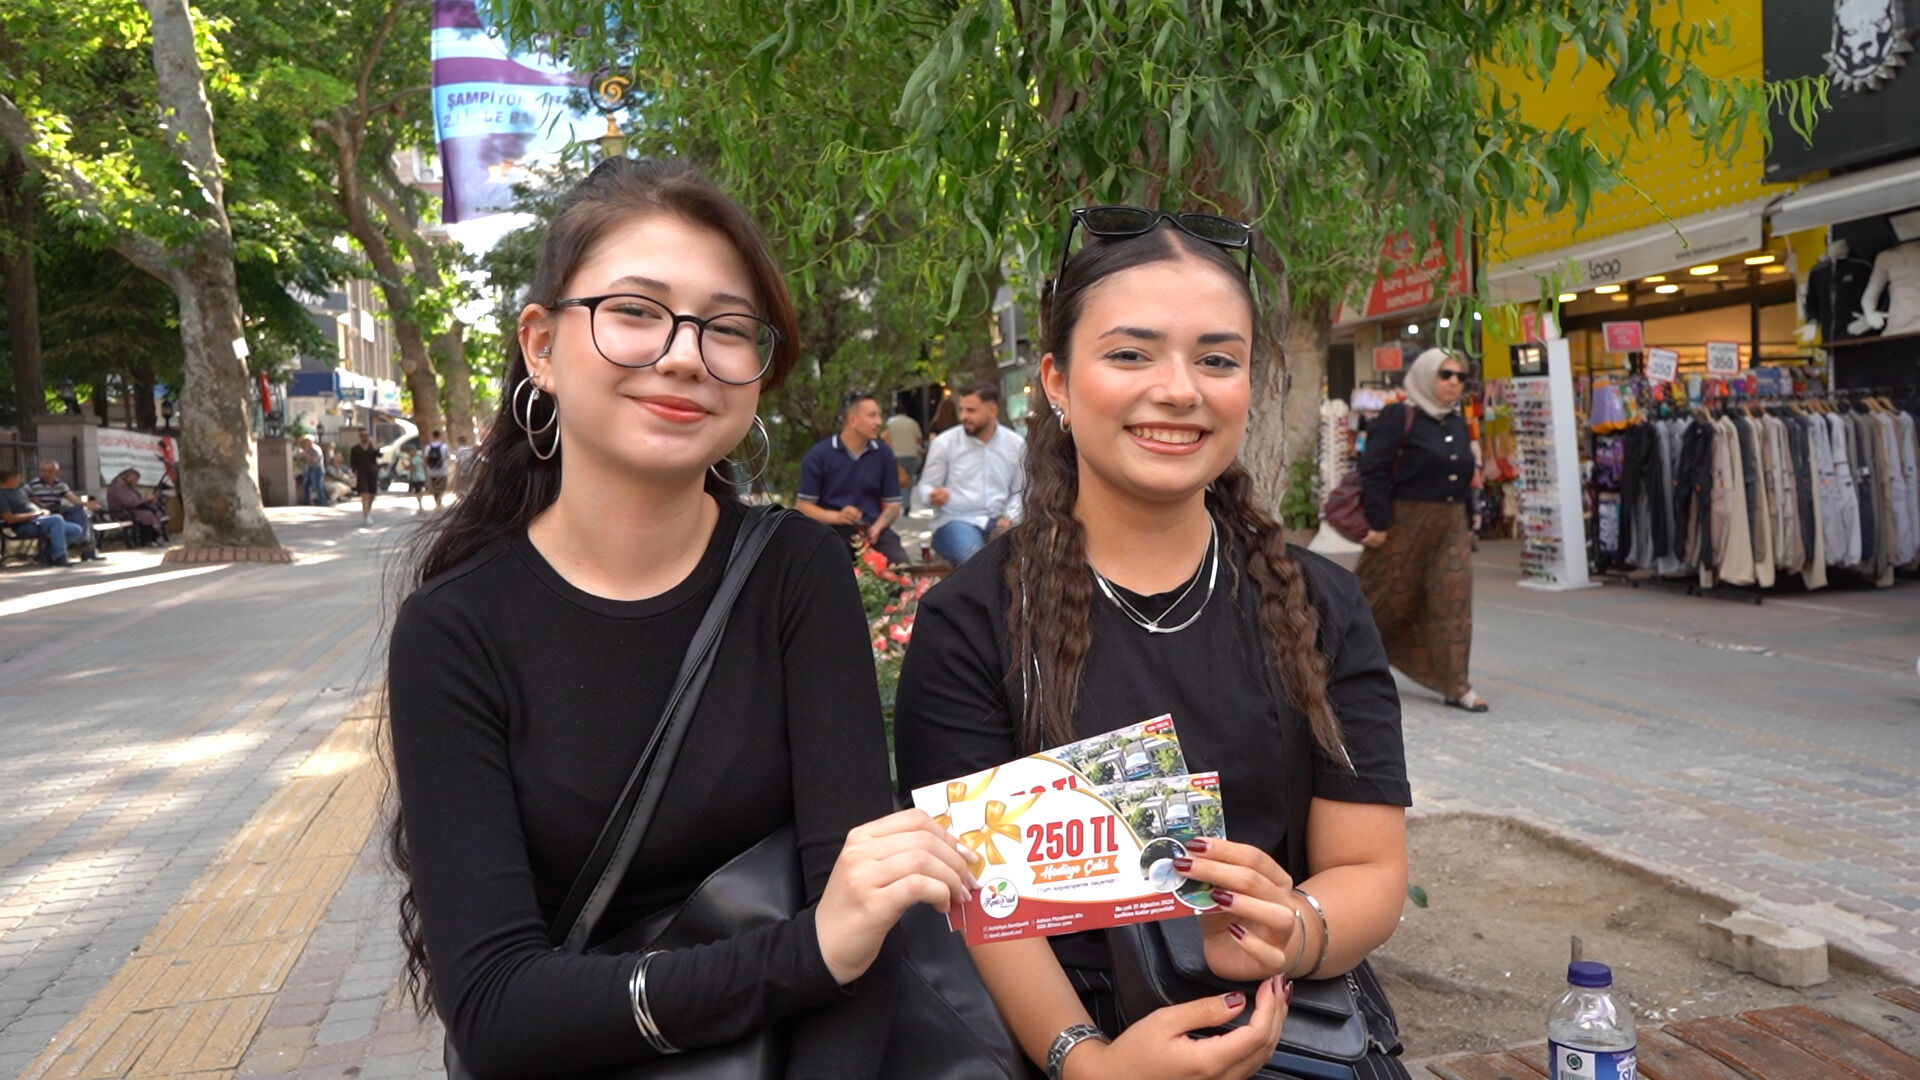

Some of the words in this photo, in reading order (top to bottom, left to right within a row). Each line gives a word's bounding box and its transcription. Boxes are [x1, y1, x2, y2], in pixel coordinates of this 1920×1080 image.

[1026, 819, 1084, 862] 250
[1090, 815, 1119, 854] TL
[1040, 864, 1081, 880] Hediye
